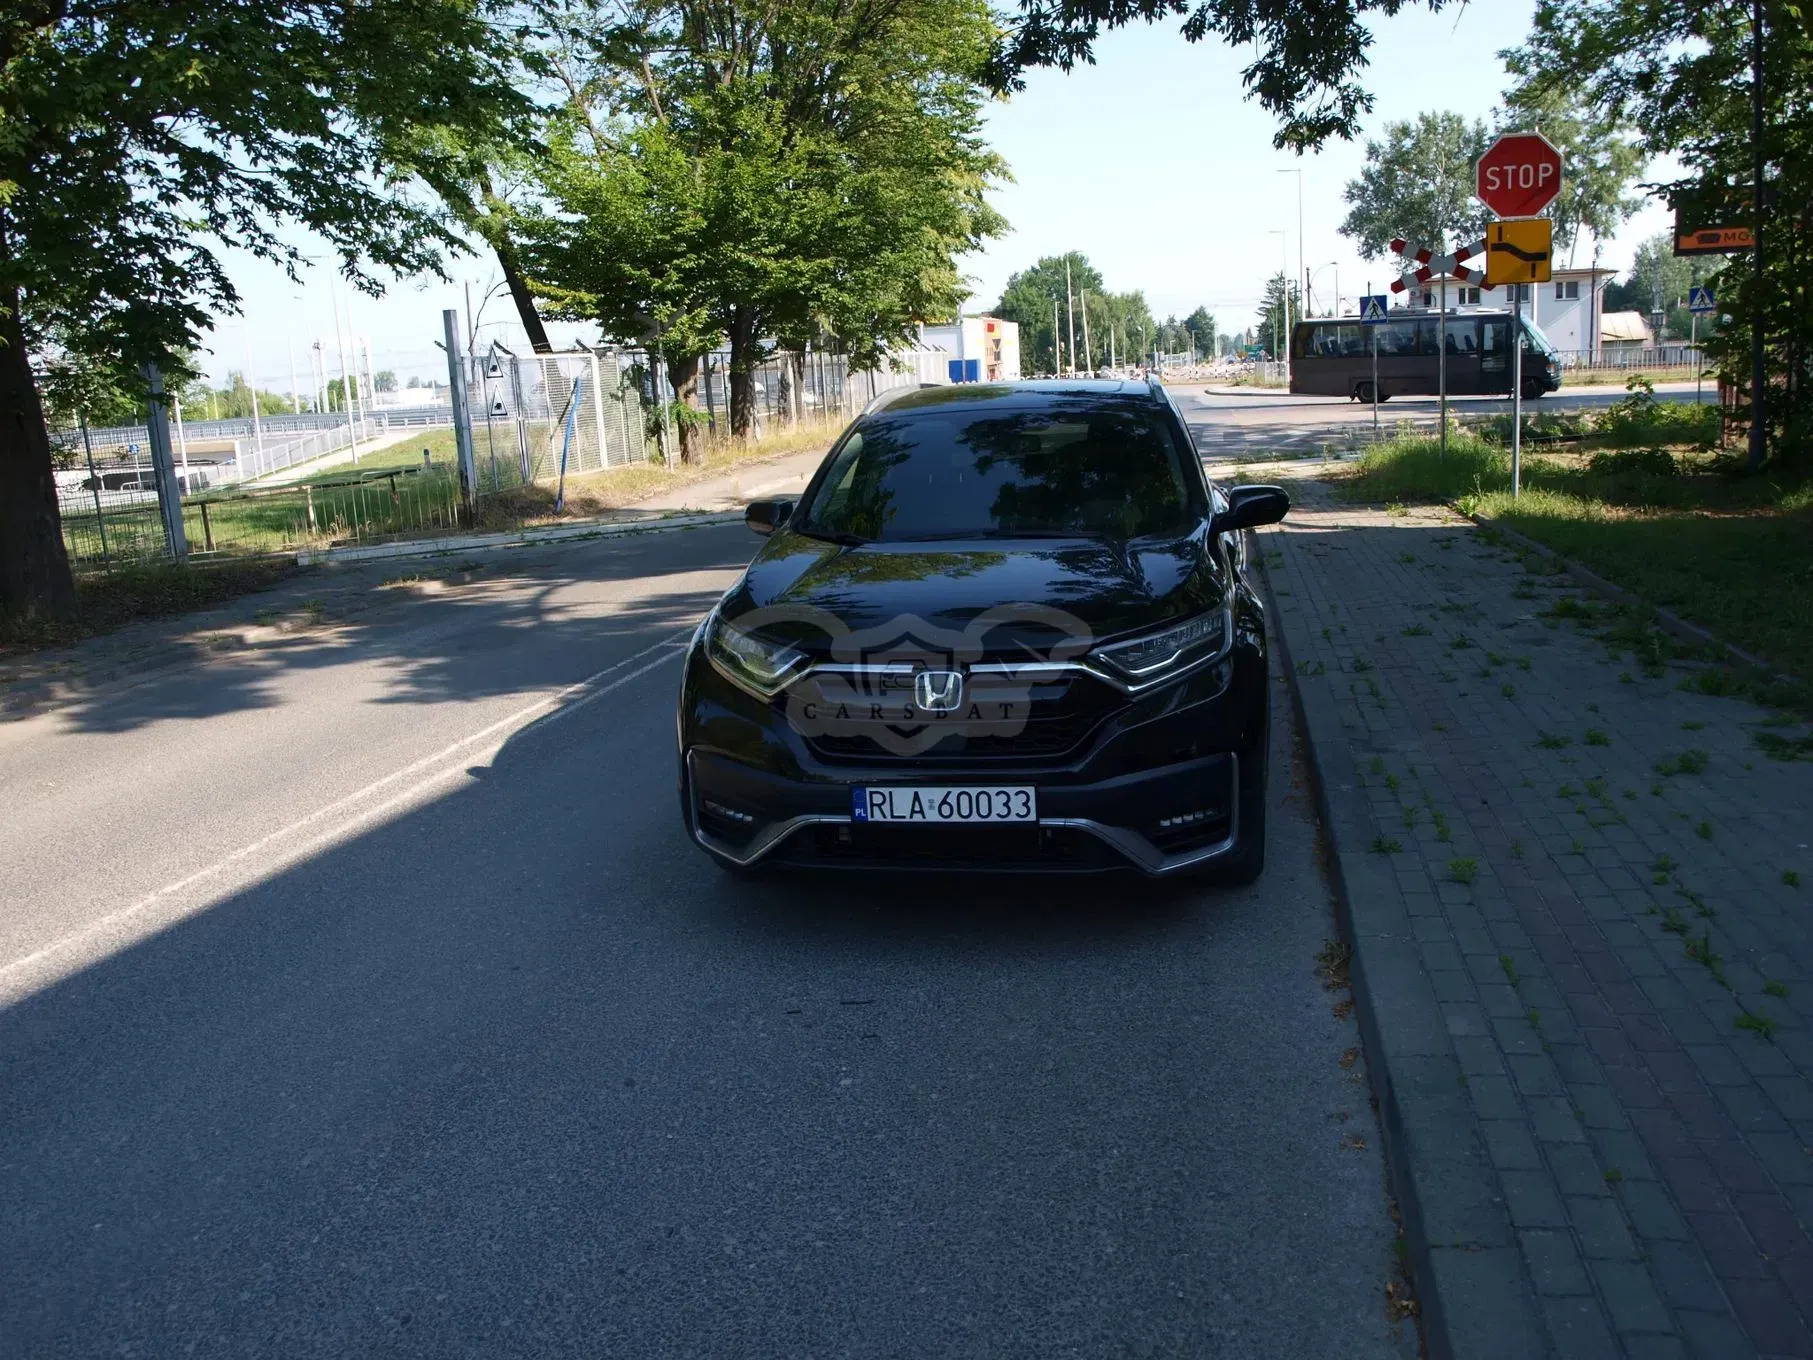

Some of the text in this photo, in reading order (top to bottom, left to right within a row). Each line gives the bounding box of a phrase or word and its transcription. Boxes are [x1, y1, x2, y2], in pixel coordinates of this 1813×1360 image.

[1486, 163, 1553, 190] STOP
[855, 808, 866, 817] PL
[869, 791, 1031, 819] RLA 60033
